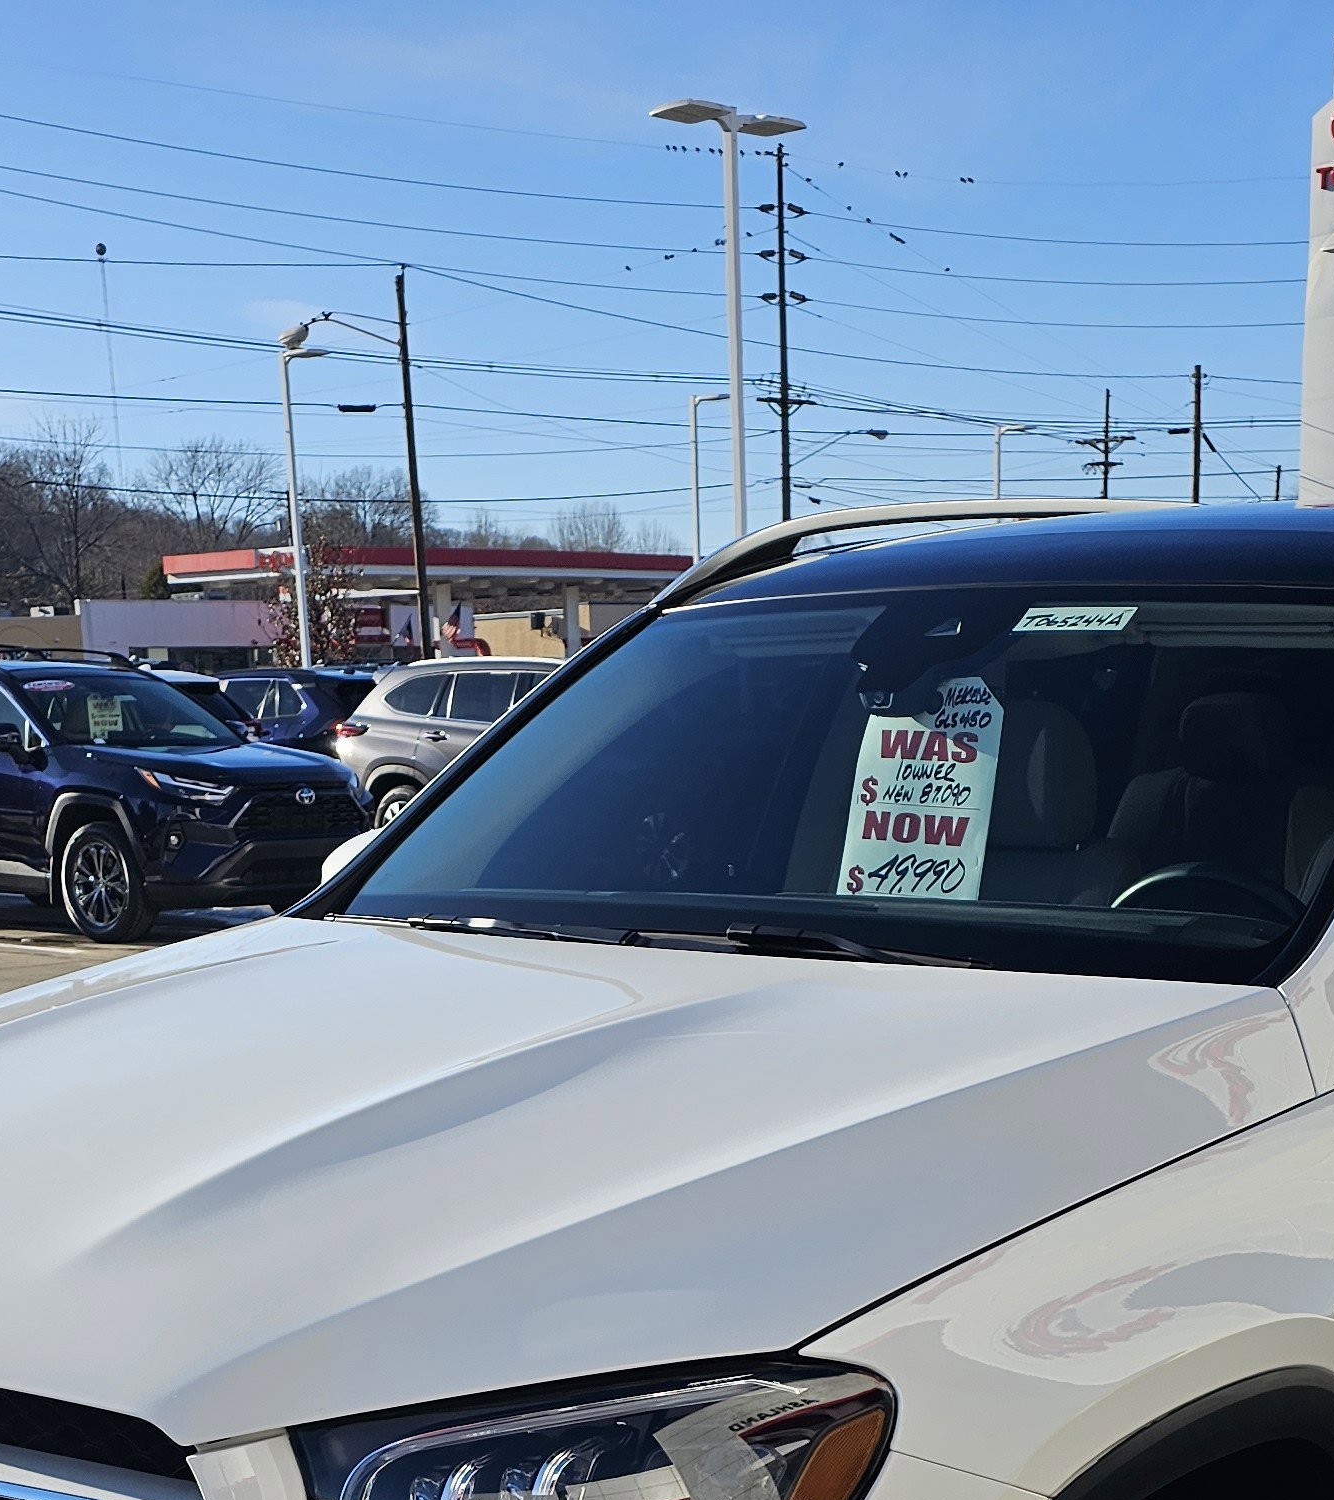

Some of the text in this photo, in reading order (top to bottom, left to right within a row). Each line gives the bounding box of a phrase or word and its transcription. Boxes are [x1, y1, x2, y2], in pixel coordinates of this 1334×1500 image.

[881, 729, 979, 763] WAS
[860, 775, 879, 806] $
[862, 810, 970, 847] NOW
[846, 864, 865, 895] $
